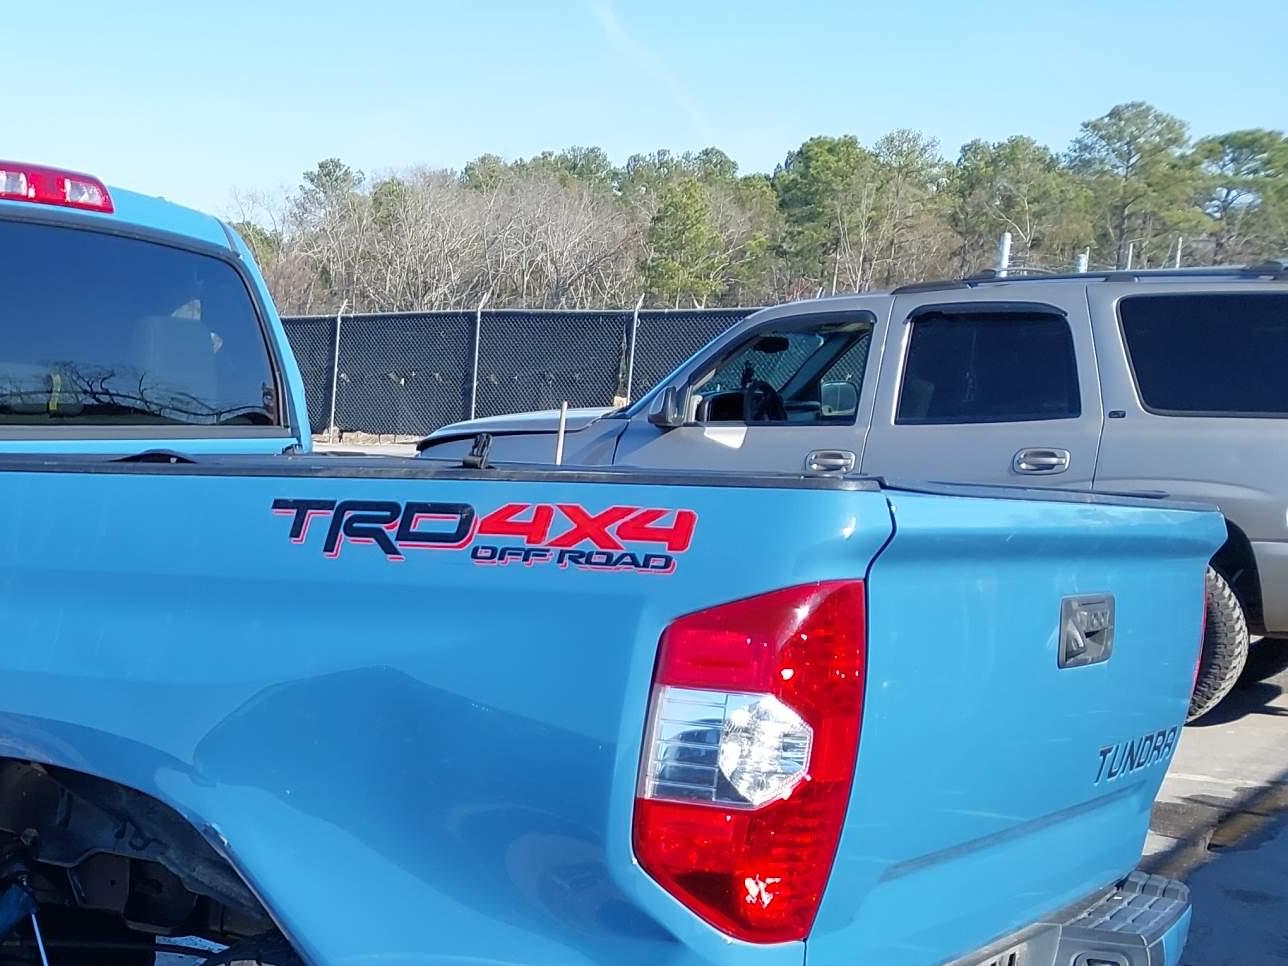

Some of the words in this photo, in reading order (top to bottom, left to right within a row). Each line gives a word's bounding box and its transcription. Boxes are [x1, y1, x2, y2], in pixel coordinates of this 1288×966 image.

[272, 499, 478, 560] TRD
[476, 502, 699, 553] 4X4
[470, 545, 553, 567] OFF
[557, 549, 677, 575] ROAD
[1094, 725, 1178, 786] TUNDRA
